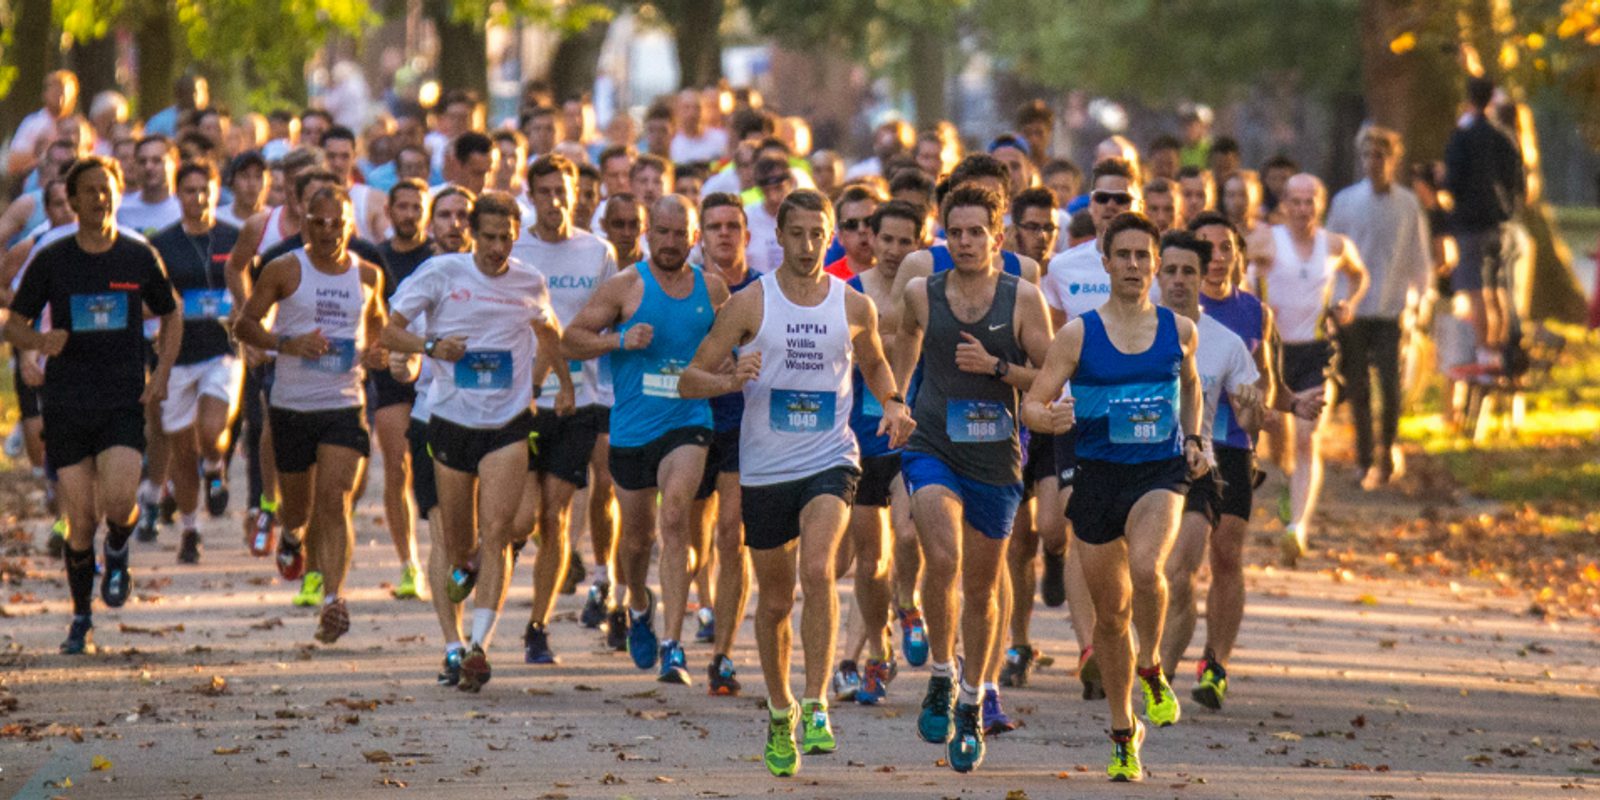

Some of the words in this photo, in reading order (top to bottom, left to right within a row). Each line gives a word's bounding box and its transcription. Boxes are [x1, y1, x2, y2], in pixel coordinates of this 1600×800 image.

[785, 338, 816, 349] Willis
[786, 349, 824, 360] Towers
[784, 360, 824, 371] Watson
[787, 413, 817, 428] 1049
[1133, 423, 1157, 438] 881
